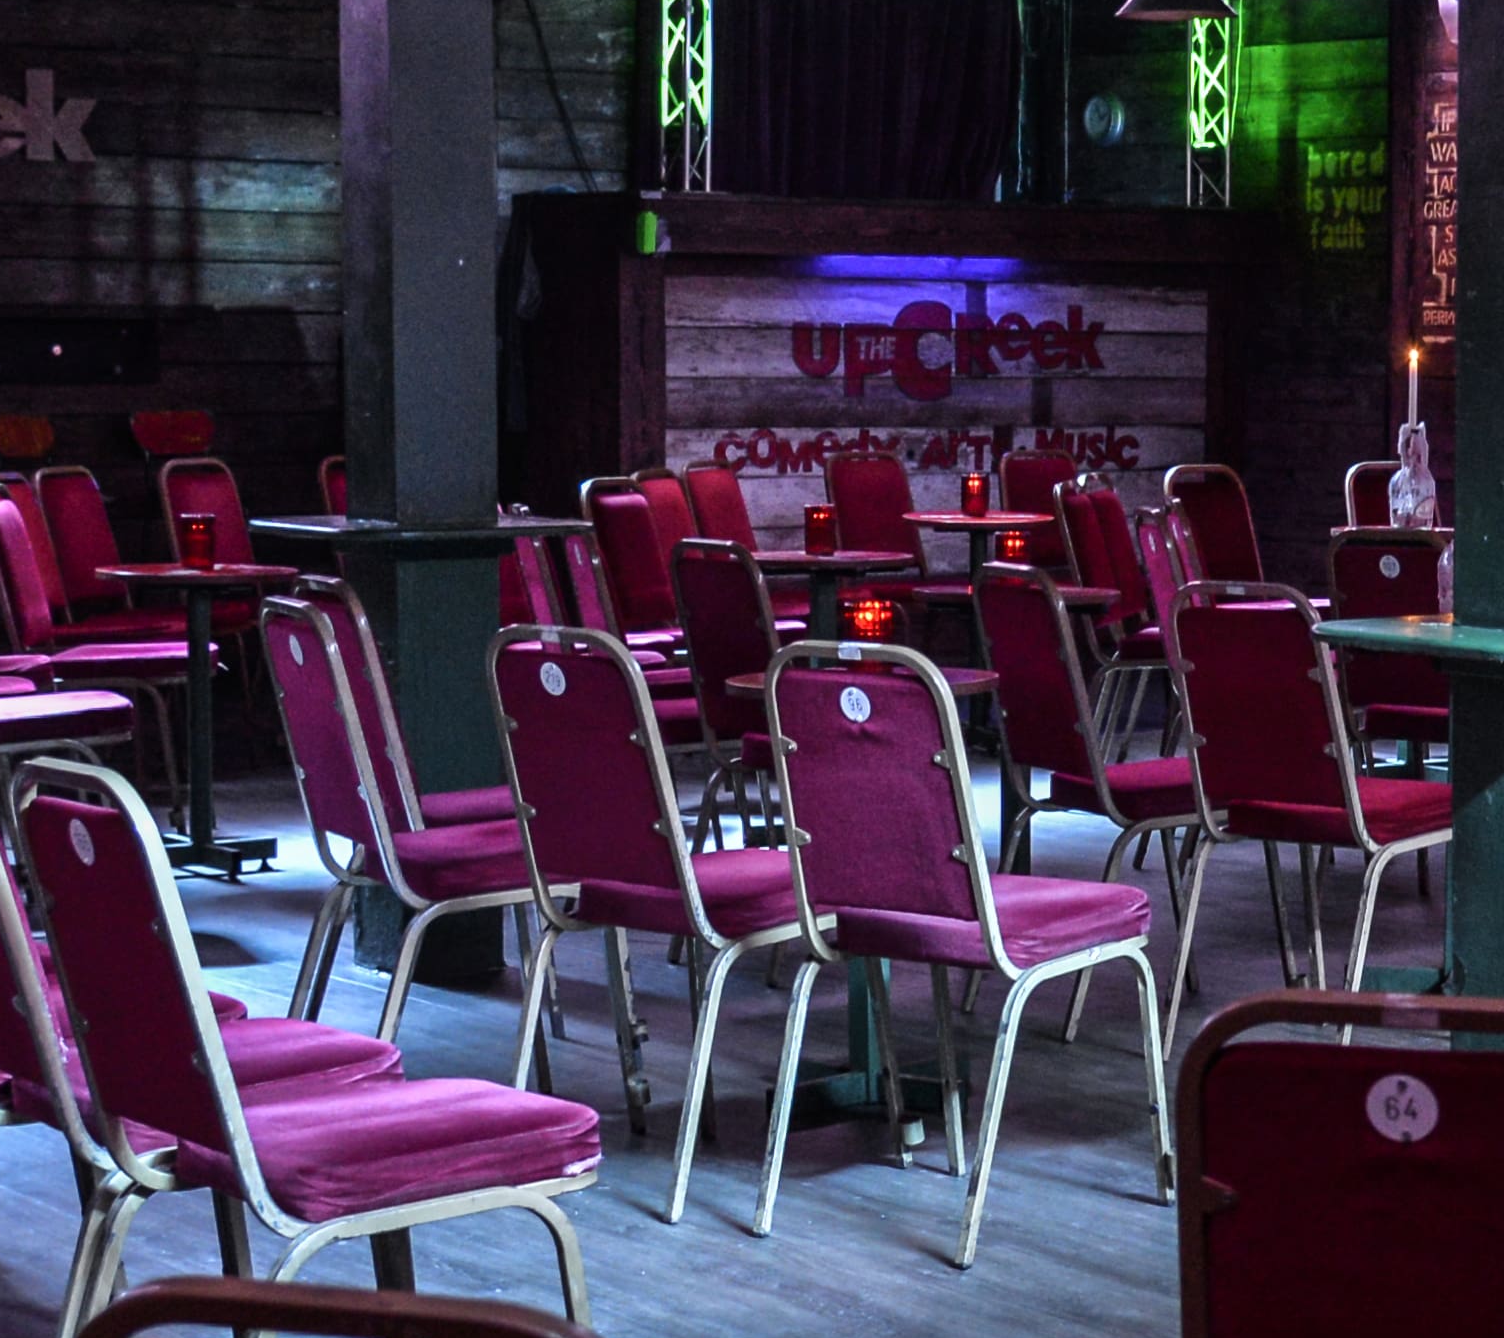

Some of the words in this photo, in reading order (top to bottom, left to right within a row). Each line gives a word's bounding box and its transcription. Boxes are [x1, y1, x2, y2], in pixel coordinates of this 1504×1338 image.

[1307, 141, 1385, 179] bored
[1331, 186, 1386, 218] your
[856, 336, 896, 360] THE
[1384, 1096, 1418, 1121] 64
